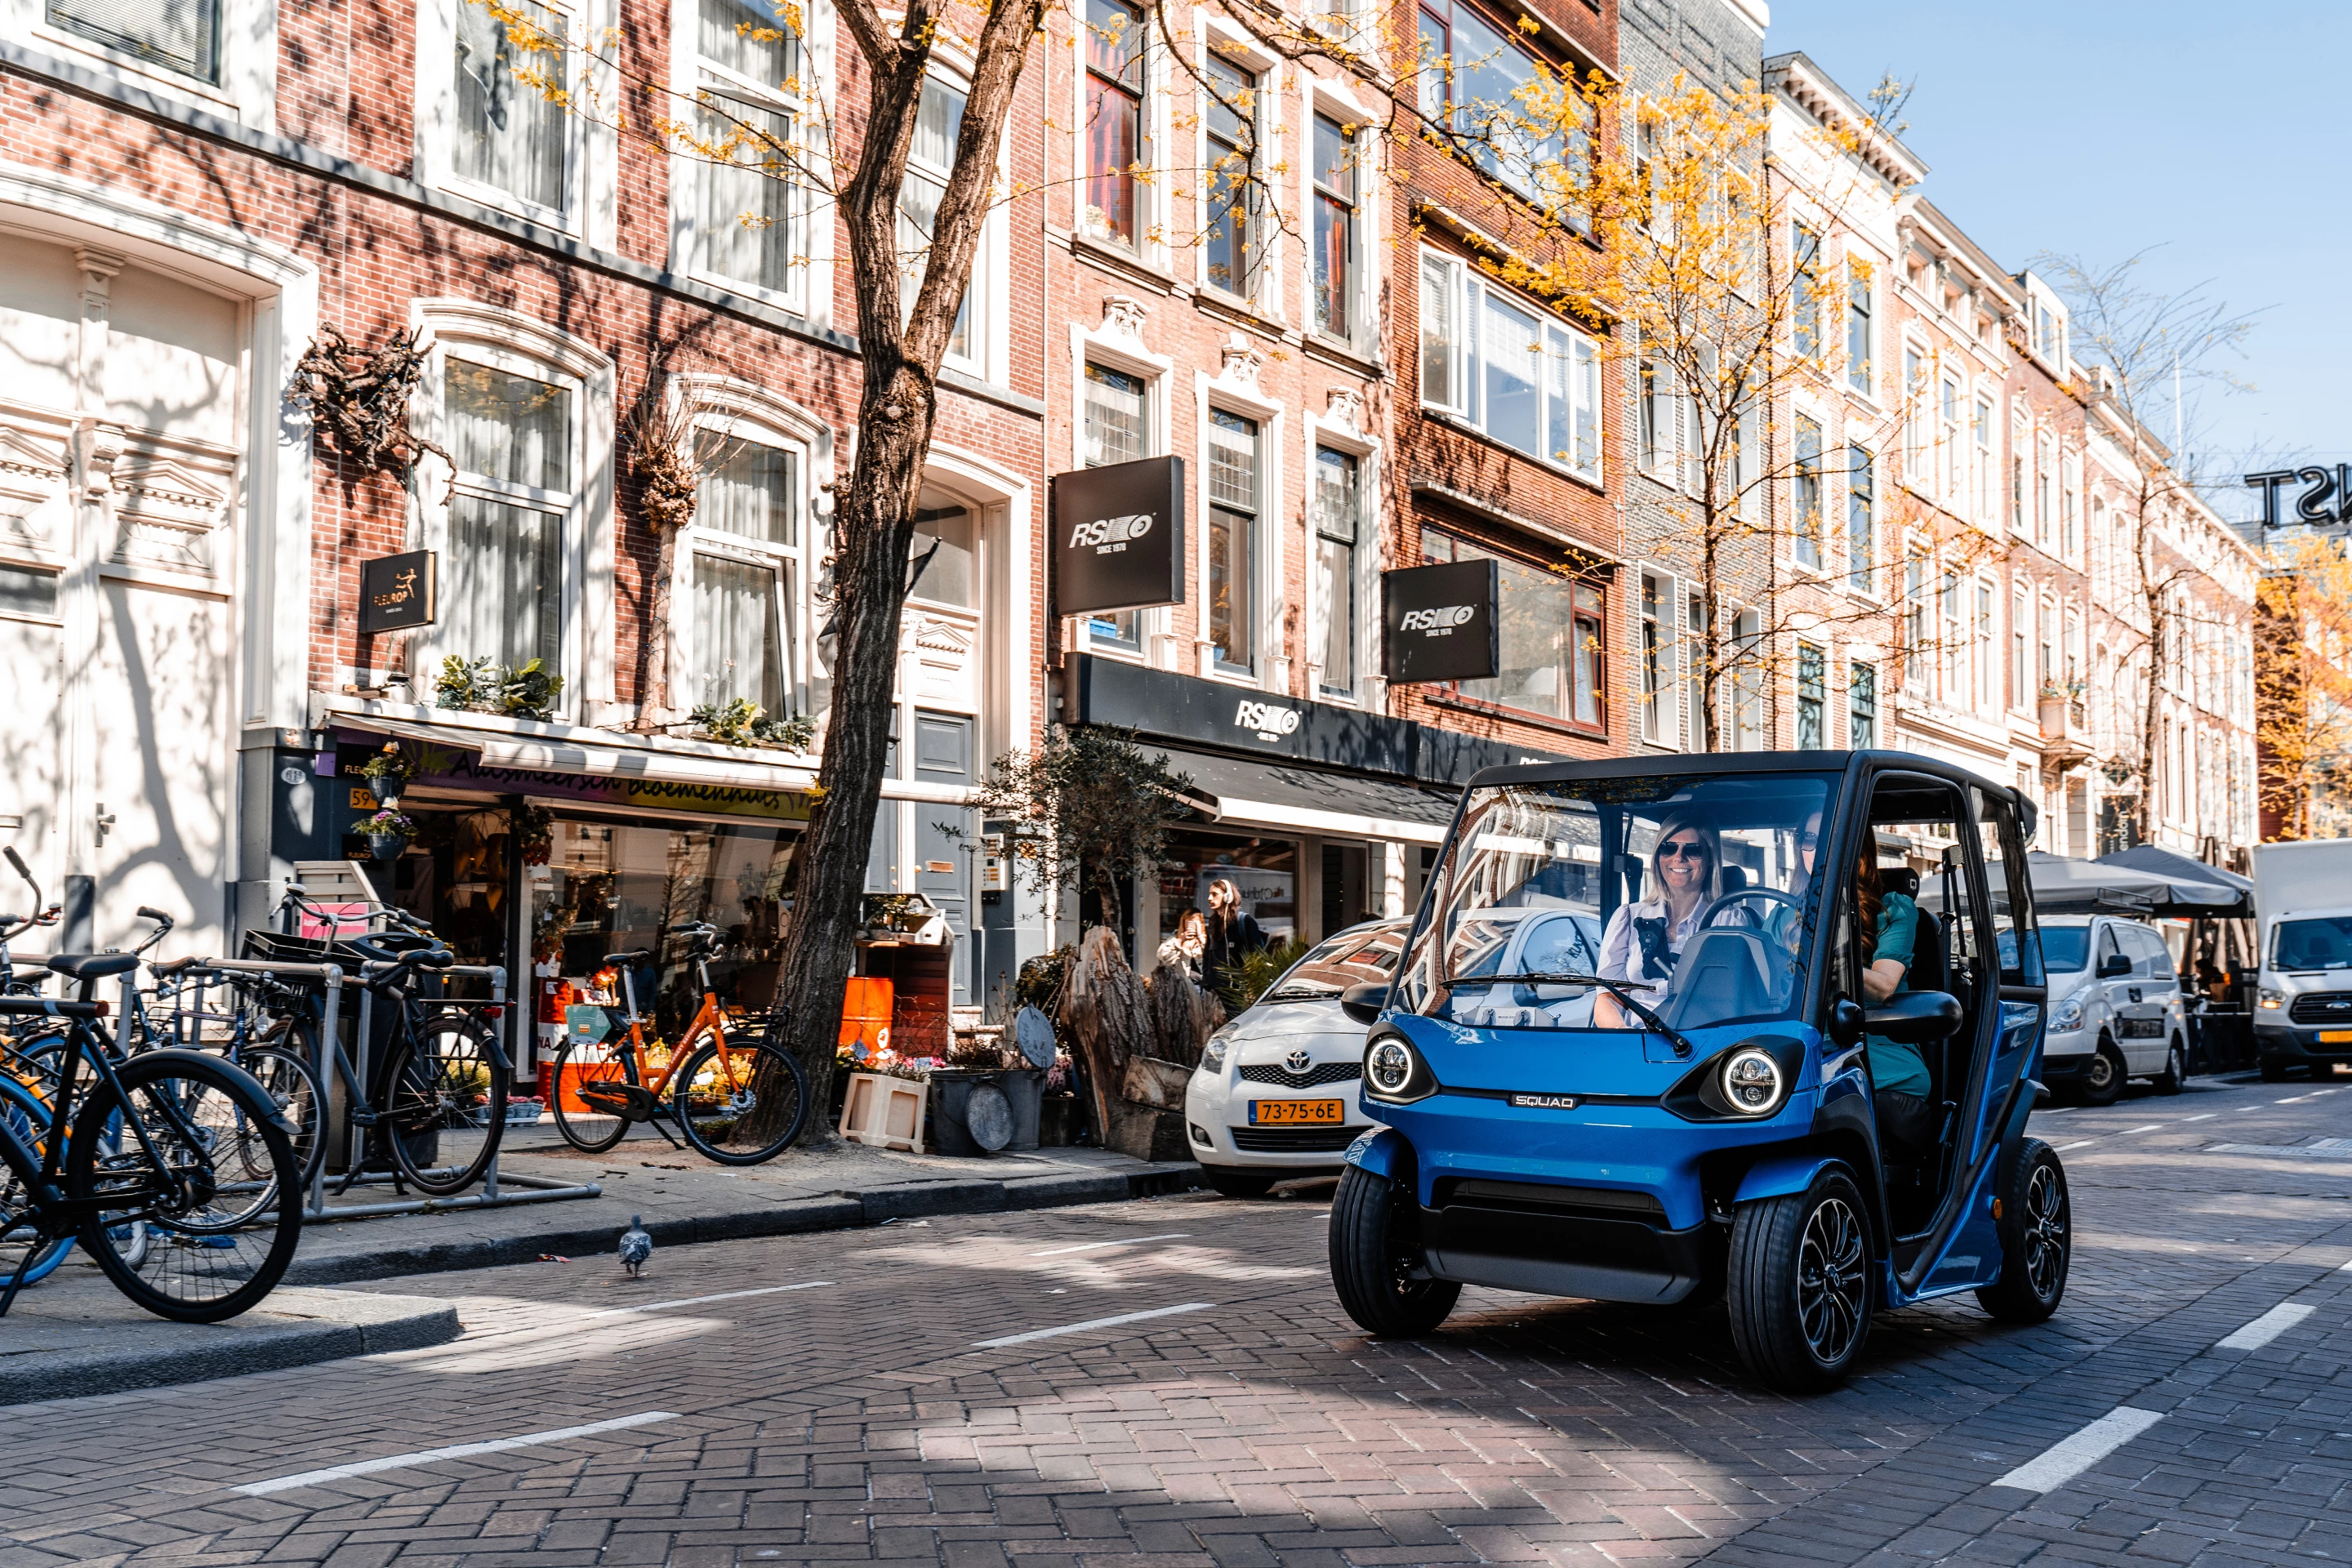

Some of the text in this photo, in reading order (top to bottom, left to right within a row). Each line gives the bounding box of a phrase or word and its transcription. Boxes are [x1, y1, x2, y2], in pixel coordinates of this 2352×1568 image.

[1096, 544, 1112, 555] SINCE
[352, 790, 371, 806] 59
[1515, 1095, 1574, 1108] SQUAD
[1263, 1103, 1335, 1120] 73-75-6E
